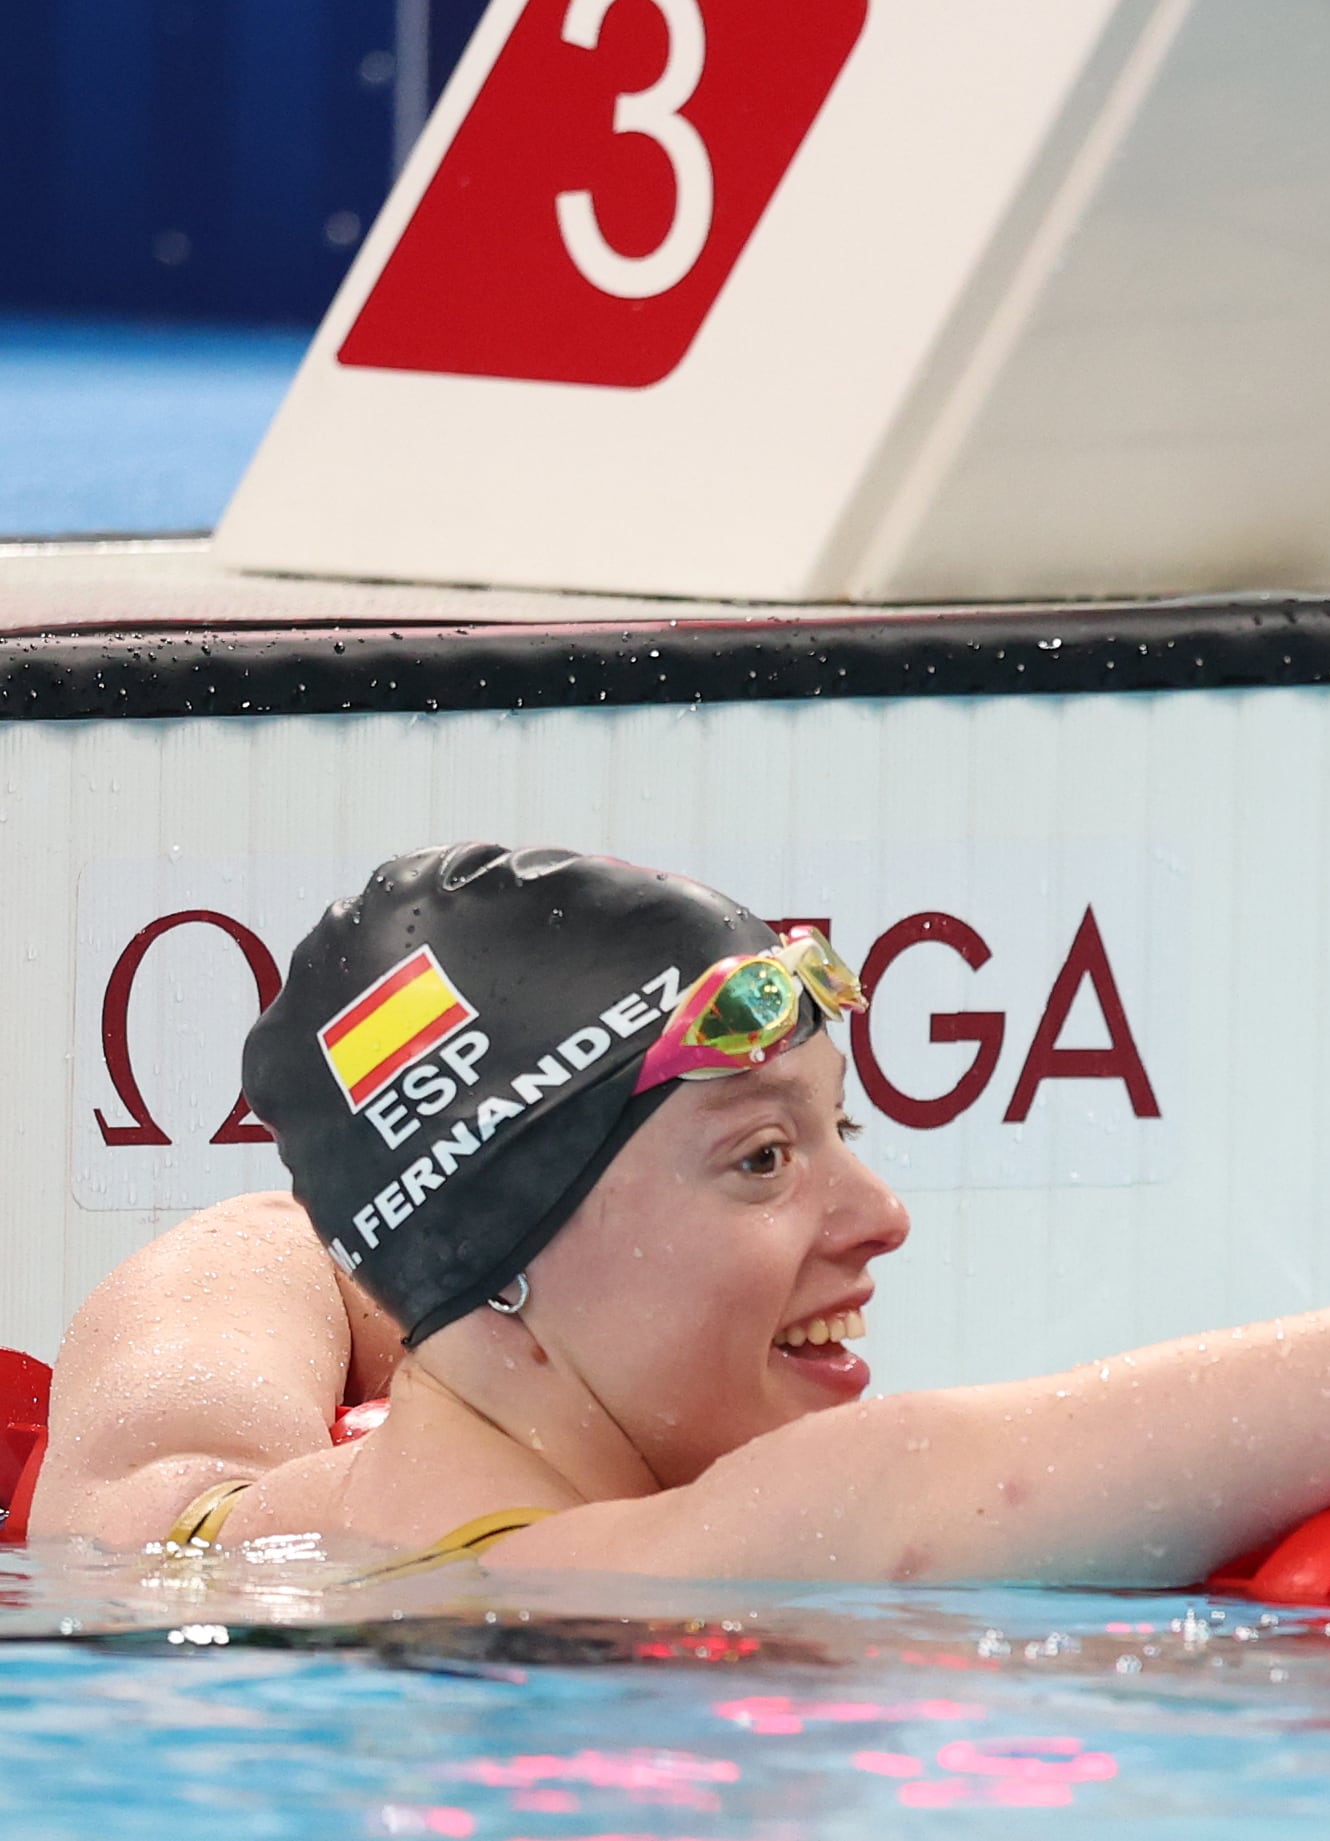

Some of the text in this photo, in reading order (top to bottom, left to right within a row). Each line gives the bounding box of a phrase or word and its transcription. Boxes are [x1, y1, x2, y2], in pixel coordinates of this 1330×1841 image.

[556, 0, 715, 299] 3
[351, 966, 692, 1250] FERNANDEZ
[364, 1031, 490, 1151] ESP
